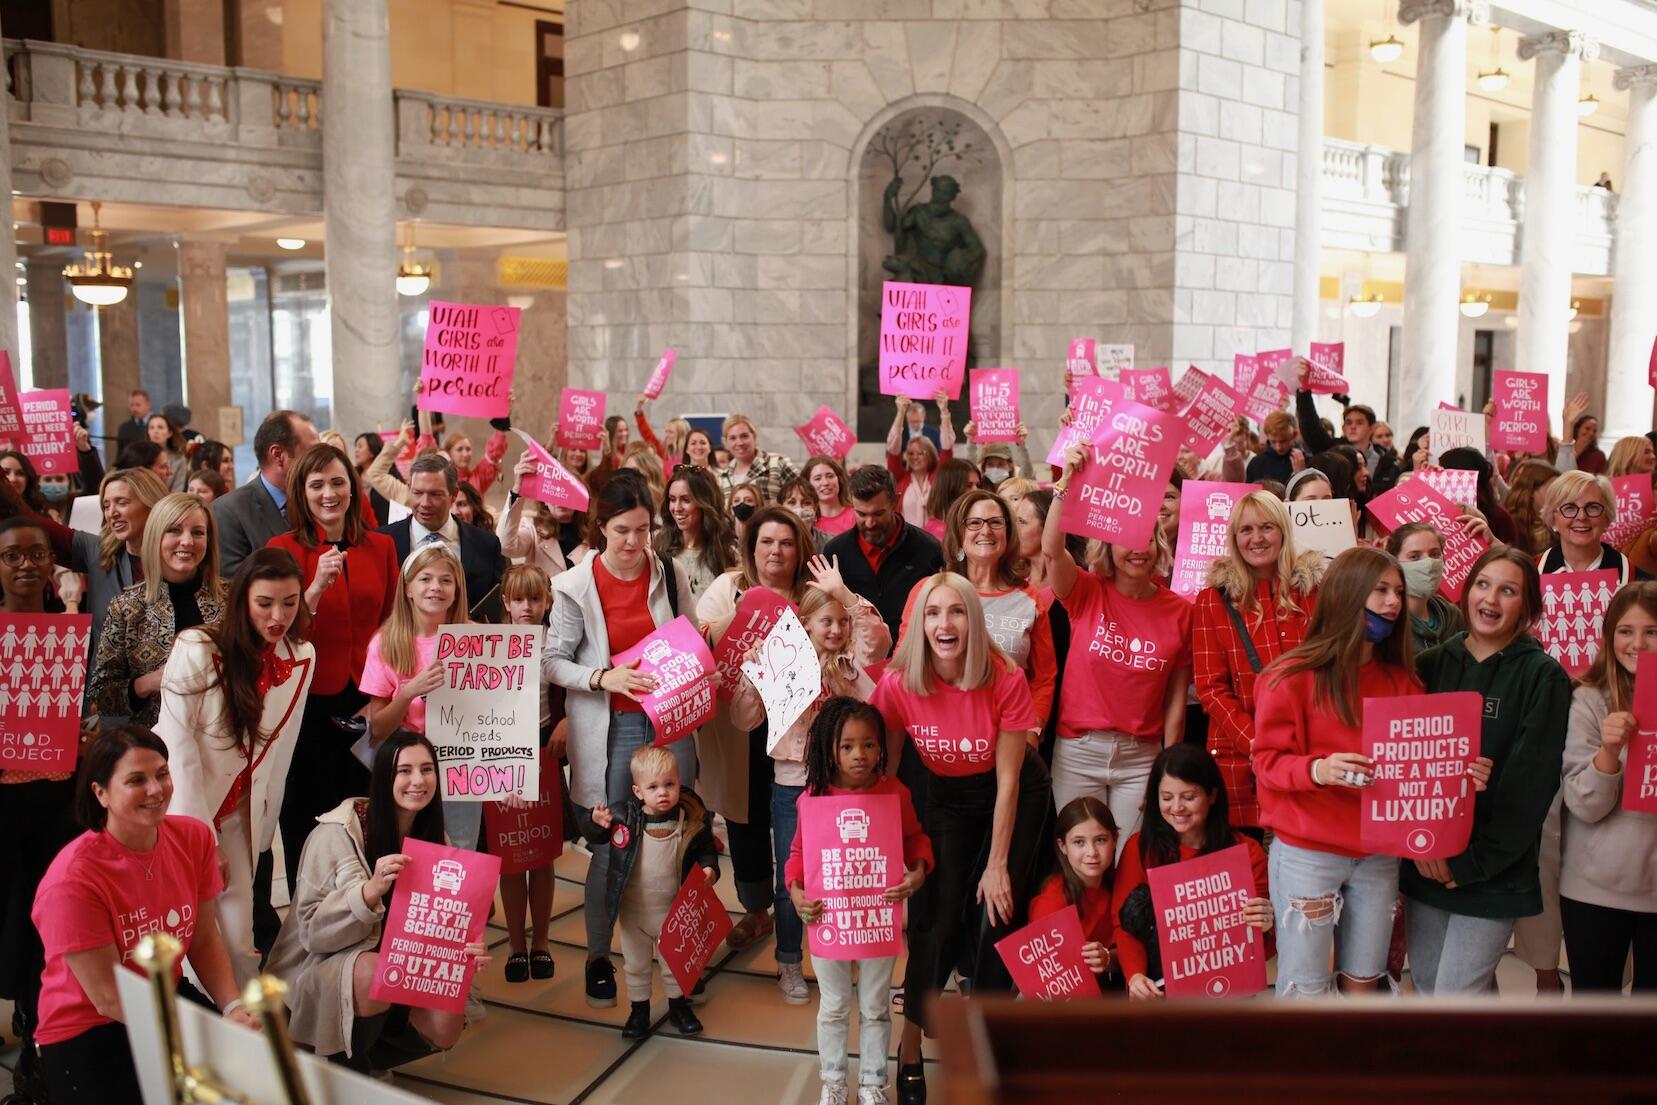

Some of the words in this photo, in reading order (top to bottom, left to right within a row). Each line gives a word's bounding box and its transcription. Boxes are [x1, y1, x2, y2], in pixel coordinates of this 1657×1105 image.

[889, 289, 927, 310] UTAH
[433, 307, 478, 329] UTAH
[896, 312, 937, 332] GIRLS
[438, 329, 480, 350] GIRLS
[884, 333, 935, 355] WORTH
[426, 349, 480, 374] WORTH
[998, 382, 1011, 399] 5
[1505, 377, 1538, 389] GIRLS
[570, 395, 597, 408] GIRLS
[1502, 399, 1541, 411] WORTH
[1512, 389, 1532, 400] ARE
[22, 411, 68, 424] RODUCTS
[566, 412, 598, 426] WORTH
[1100, 398, 1113, 418] 5
[1111, 412, 1163, 443] GIRLS
[1437, 413, 1471, 433] GIRL
[1111, 435, 1150, 460] ARE
[1433, 431, 1474, 449] POWER
[1094, 446, 1159, 481] WORTH
[1108, 472, 1126, 492] IT.
[1079, 483, 1143, 518] PERIOD.
[1404, 505, 1427, 523] in
[1416, 495, 1442, 516] 5
[1627, 492, 1643, 511] 5
[1086, 519, 1123, 535] PROJECT
[1088, 512, 1119, 525] PERIOD
[1192, 521, 1208, 533] BE
[1210, 522, 1228, 534] CO
[1191, 533, 1228, 546] STAY
[437, 633, 503, 660] DON'T
[507, 634, 535, 659] BE
[1095, 625, 1156, 654] PERIOD
[1088, 640, 1168, 672] PROJECT
[447, 662, 525, 691] TARDY!
[653, 664, 705, 699] SCHOOL!
[654, 695, 681, 715] PERIOD
[659, 712, 673, 726] FOR
[673, 686, 712, 721] UTAH
[675, 699, 712, 733] STUDENTS!
[440, 704, 464, 736] My
[911, 724, 939, 737] THE
[1389, 715, 1454, 739] PERIOD
[462, 727, 502, 743] needs
[914, 736, 989, 753] PERIOD
[2, 748, 65, 762] OJECT
[434, 745, 475, 758] PERIOD
[481, 746, 533, 758] PRODUCTS
[1372, 737, 1470, 762] PRODUCTS
[446, 764, 526, 796] NOW!
[1373, 763, 1405, 780] ARE
[1409, 763, 1421, 779] A
[1398, 781, 1428, 797] NOT
[1432, 780, 1443, 797] A
[821, 849, 842, 862] BE
[845, 846, 888, 862] COOL,
[821, 861, 866, 877] STAY
[869, 860, 888, 874] IN
[822, 874, 887, 891] SCHOOL!
[1174, 871, 1232, 903] PERIOD
[409, 891, 431, 908] BE
[433, 896, 473, 918] COOL,
[667, 888, 699, 934] GIRLS
[822, 897, 849, 911] ERIOD
[1164, 888, 1249, 928] PRODUCTS
[118, 906, 149, 926] THE
[406, 905, 453, 926] STAY
[453, 914, 472, 930] IN
[674, 899, 709, 953] WORTH
[678, 904, 699, 936] ARE
[818, 912, 834, 925] OR
[836, 908, 894, 930] UTAH
[403, 920, 468, 944] SCHOOL!
[839, 927, 894, 946] STUDENTS!
[1169, 924, 1196, 944] ARE
[1200, 921, 1210, 936] A
[1192, 934, 1217, 954] NOT
[1221, 931, 1231, 947] A
[391, 937, 425, 955] PERIOD
[425, 943, 469, 964] PRODUCTS
[1018, 928, 1065, 965] GIRLS
[387, 952, 406, 966] FOR
[406, 956, 467, 983] UTAH
[1037, 951, 1064, 983] ARE
[402, 975, 462, 998] STUDENTS!
